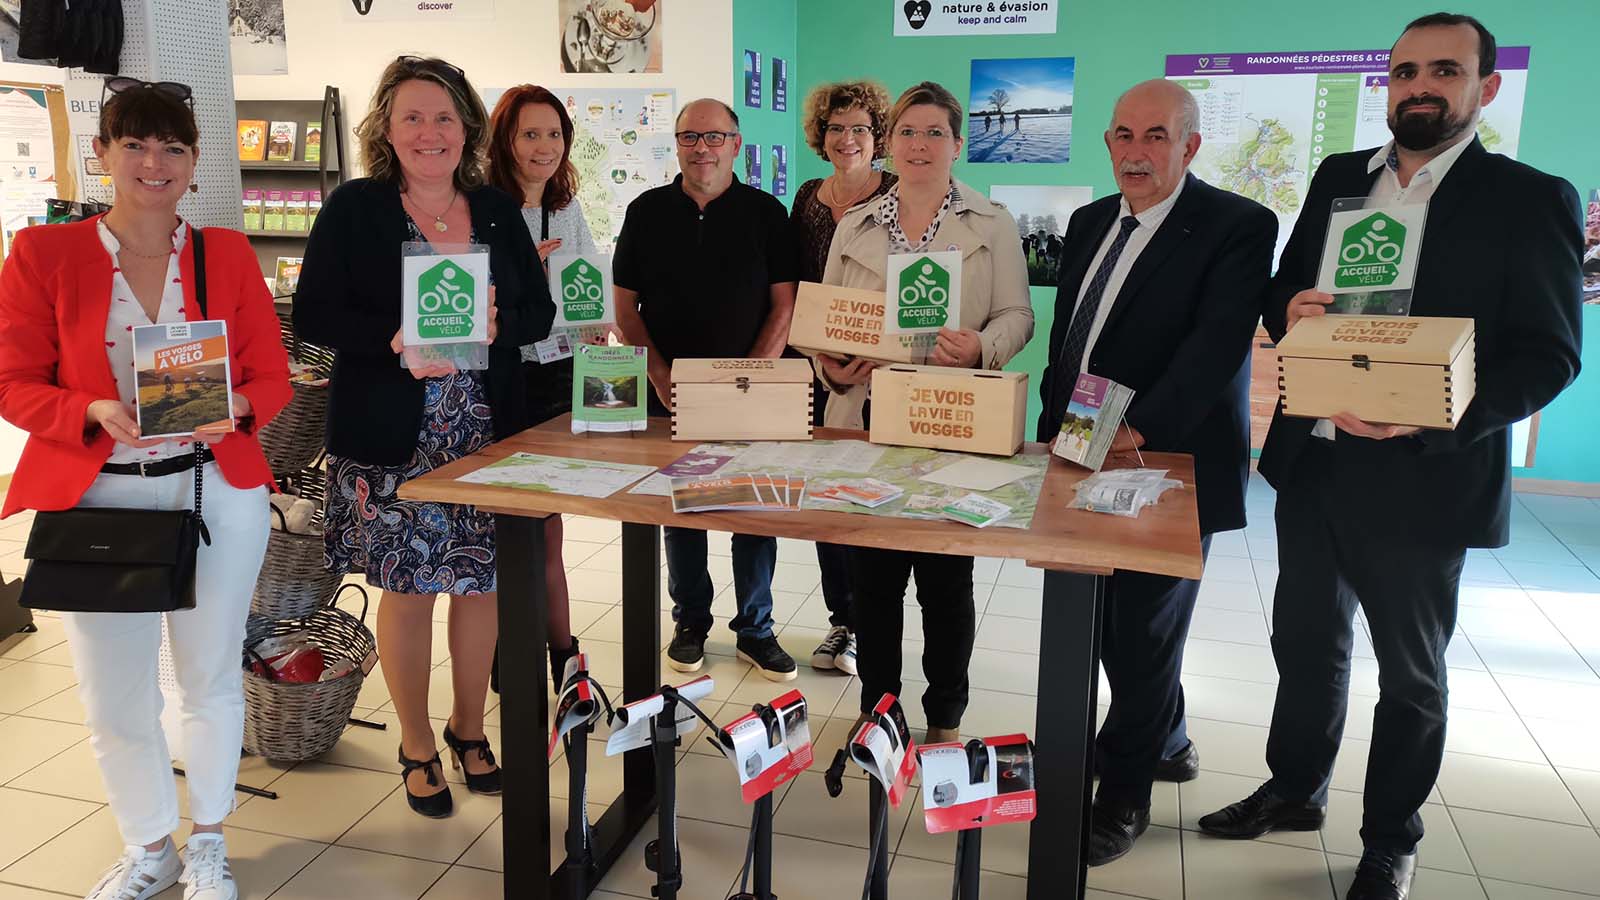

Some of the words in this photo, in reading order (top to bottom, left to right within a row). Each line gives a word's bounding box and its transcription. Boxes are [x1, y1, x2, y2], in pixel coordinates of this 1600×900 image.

[417, 2, 453, 10] discover
[942, 3, 983, 13] nature
[986, 2, 996, 12] &
[1000, 1, 1048, 12] évasion
[957, 15, 981, 25] keep
[983, 15, 1001, 24] and
[1004, 15, 1027, 23] calm
[1246, 54, 1310, 64] RANDONNÉES
[1311, 53, 1365, 63] PÉDESTRES
[1366, 54, 1373, 62] &
[1340, 265, 1389, 277] ACCUEIL
[1359, 274, 1384, 284] VÉLO
[567, 303, 598, 312] ACCUEIL
[830, 298, 849, 312] JE
[851, 300, 885, 317] VOIS
[902, 309, 940, 318] ACCUEIL
[423, 316, 465, 326] ACCUEIL
[826, 313, 843, 325] LA
[844, 316, 865, 328] VIE
[917, 316, 937, 325] VÉLO
[1341, 320, 1368, 328] JE
[1370, 320, 1420, 329] VOIS
[440, 325, 461, 335] VÉLO
[825, 326, 880, 345] VOSGES
[1332, 334, 1409, 345] VOSGES
[157, 350, 171, 359] LES
[171, 342, 202, 355] VOSGES
[911, 388, 931, 403] JE
[933, 389, 975, 406] VOIS
[909, 406, 928, 418] LA
[929, 407, 952, 420] VIE
[909, 421, 974, 439] VOSGES
